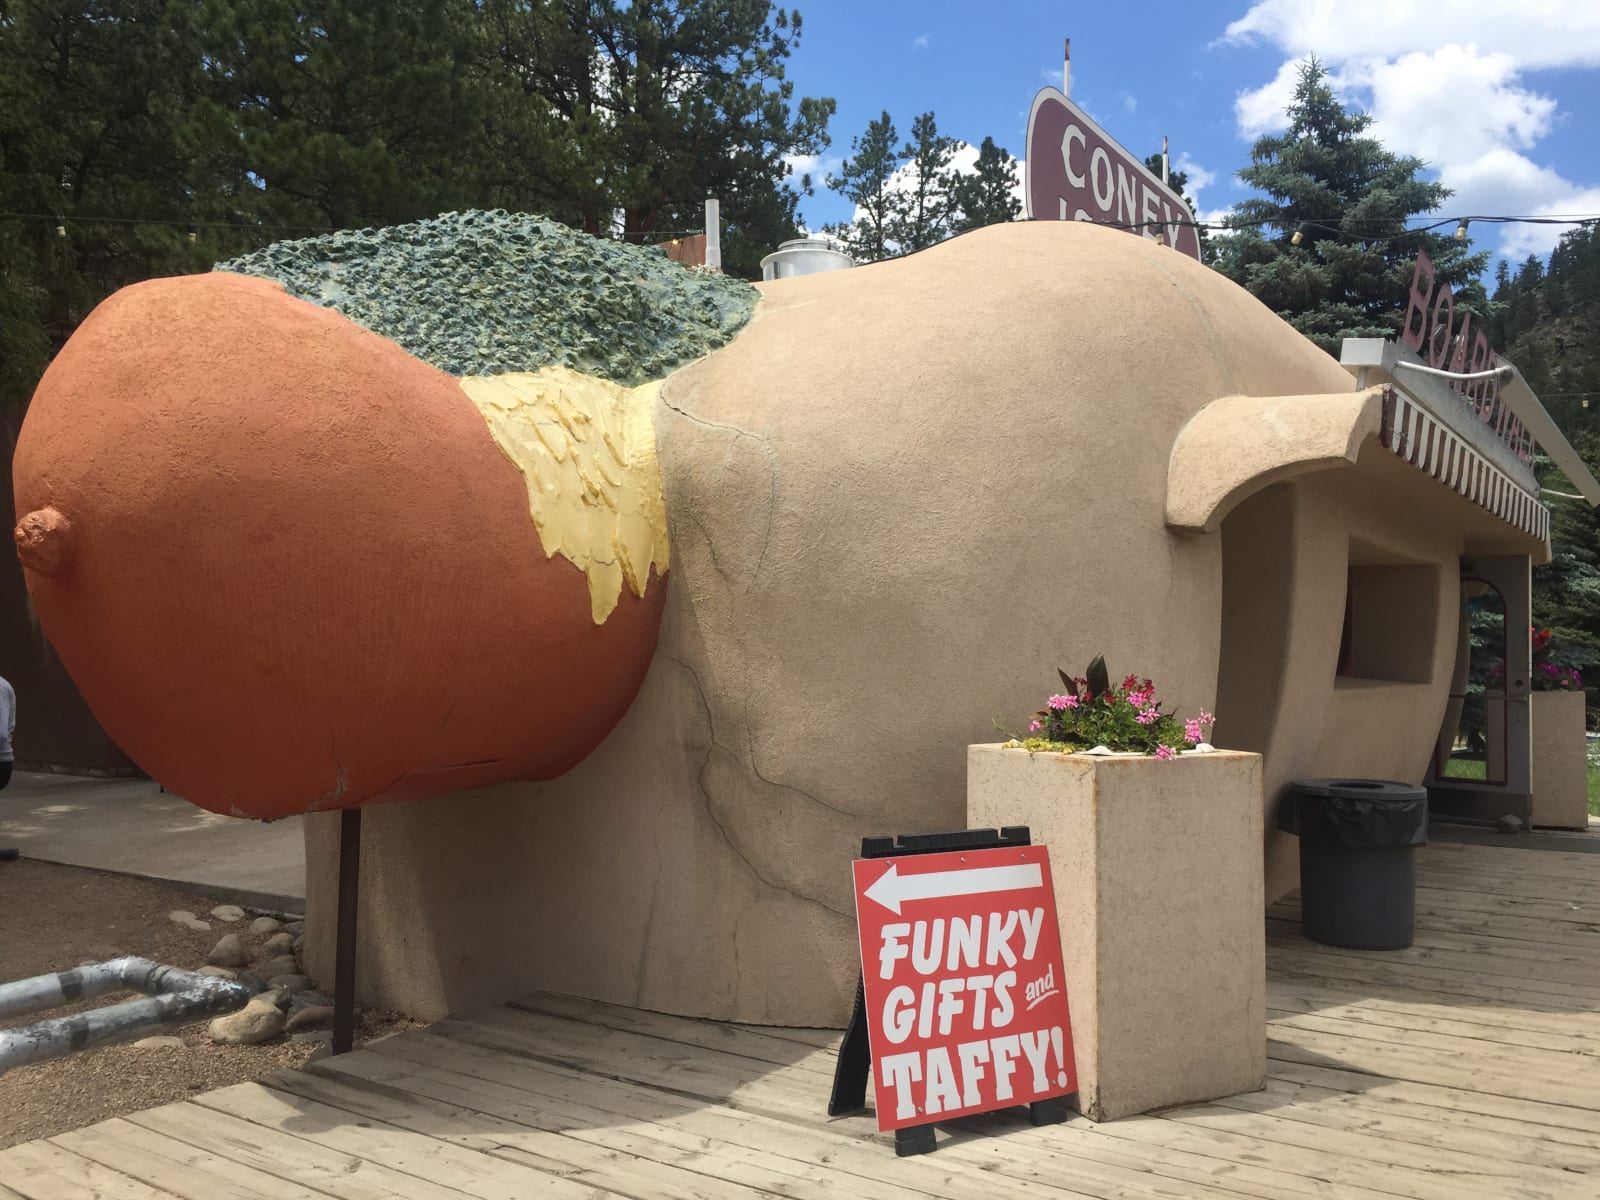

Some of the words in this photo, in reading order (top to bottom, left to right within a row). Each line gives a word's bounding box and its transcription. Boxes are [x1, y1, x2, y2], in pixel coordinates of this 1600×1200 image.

[1061, 123, 1183, 249] CONEY
[879, 907, 1044, 980] FUNKY
[882, 970, 1017, 1044] GIFTS
[1025, 963, 1056, 1001] and
[880, 1026, 1068, 1120] TAFFY!
